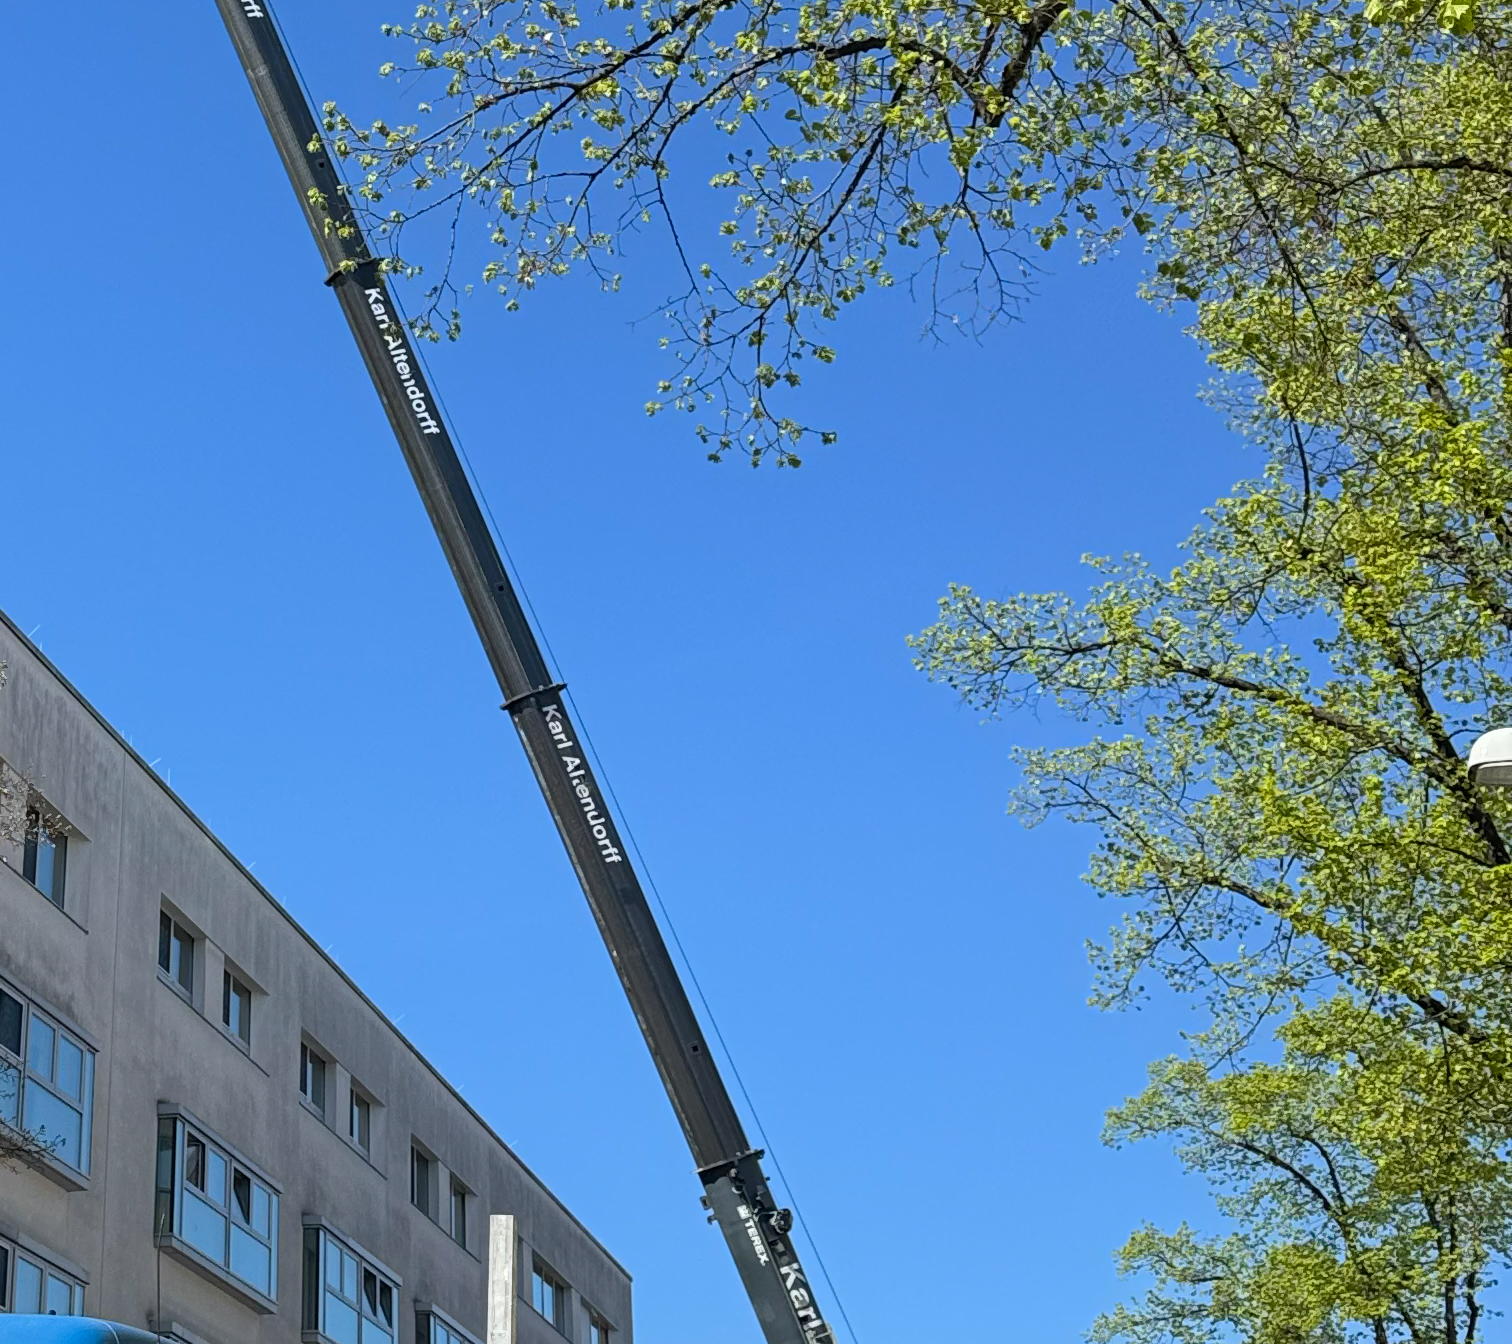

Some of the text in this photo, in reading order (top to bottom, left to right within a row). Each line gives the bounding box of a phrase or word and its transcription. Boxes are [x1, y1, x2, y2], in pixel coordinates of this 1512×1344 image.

[384, 334, 441, 435] Altendorff
[542, 704, 574, 749] Karl
[744, 1218, 770, 1267] TEREX
[779, 1261, 824, 1332] Karl
